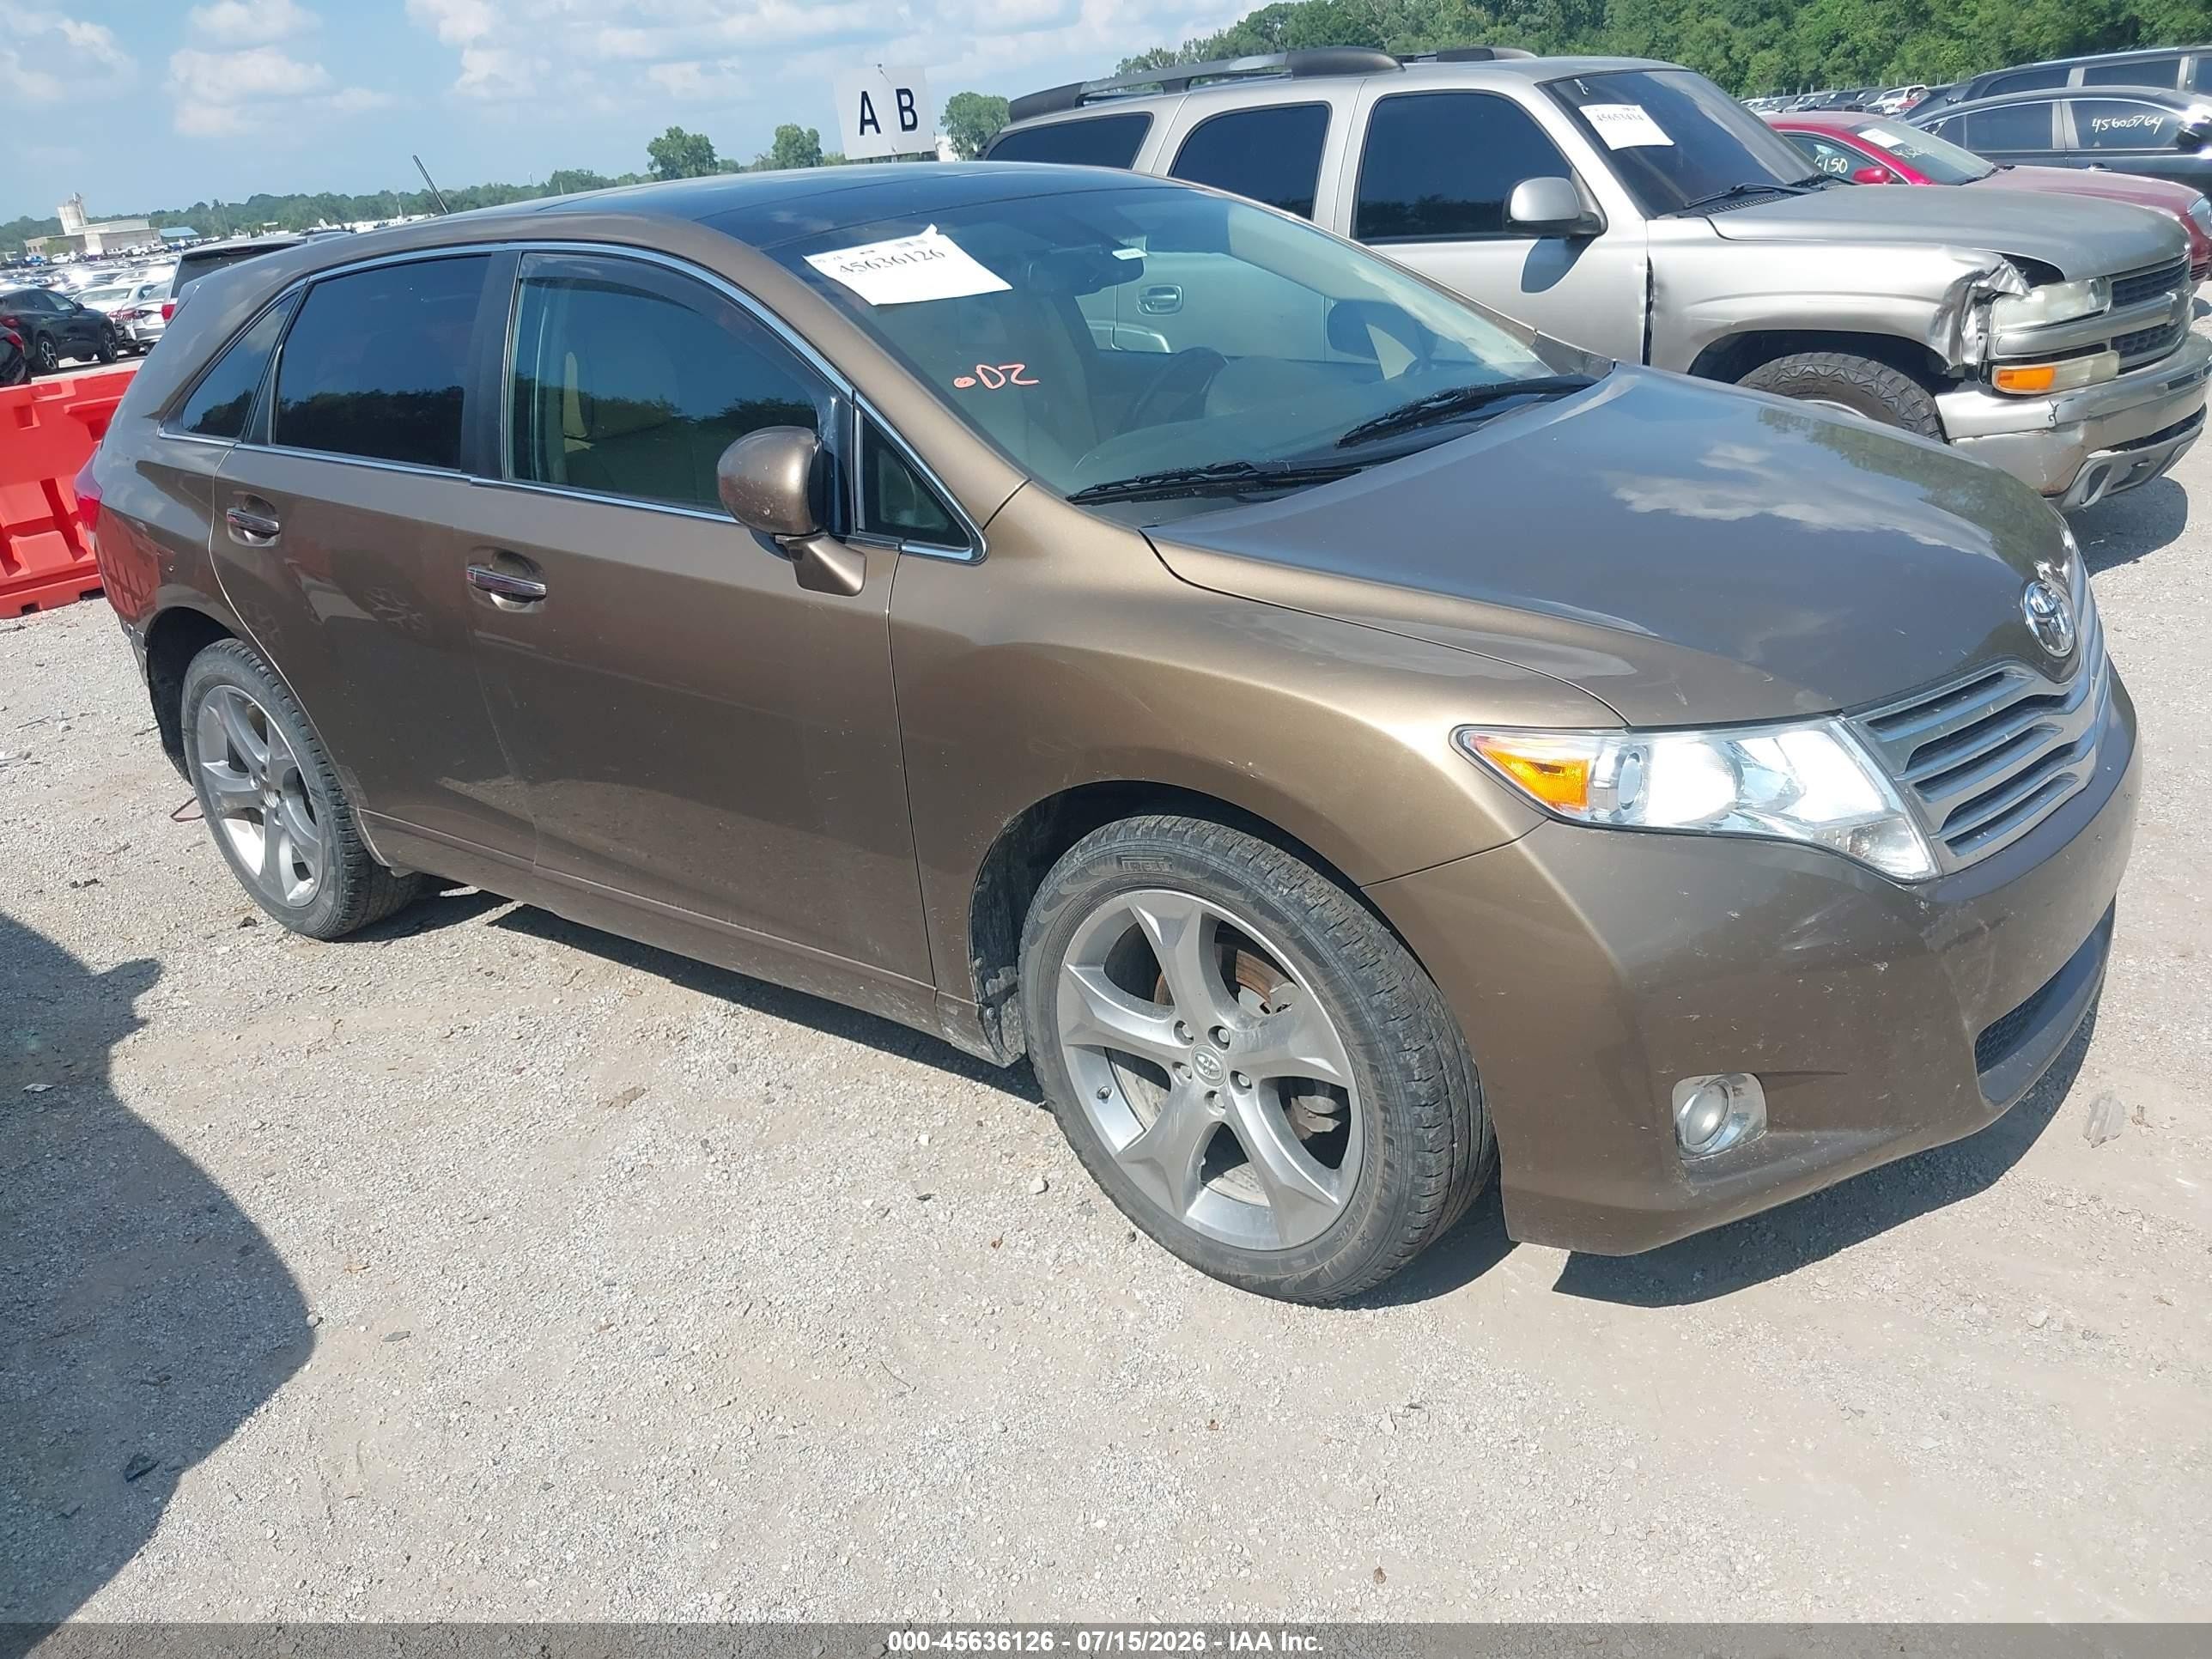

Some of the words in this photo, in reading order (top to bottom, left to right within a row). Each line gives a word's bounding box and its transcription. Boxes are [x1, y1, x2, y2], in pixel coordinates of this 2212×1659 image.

[859, 90, 882, 137] A
[895, 88, 919, 132] B
[2092, 115, 2165, 135] 45600764
[840, 249, 946, 274] 45636126
